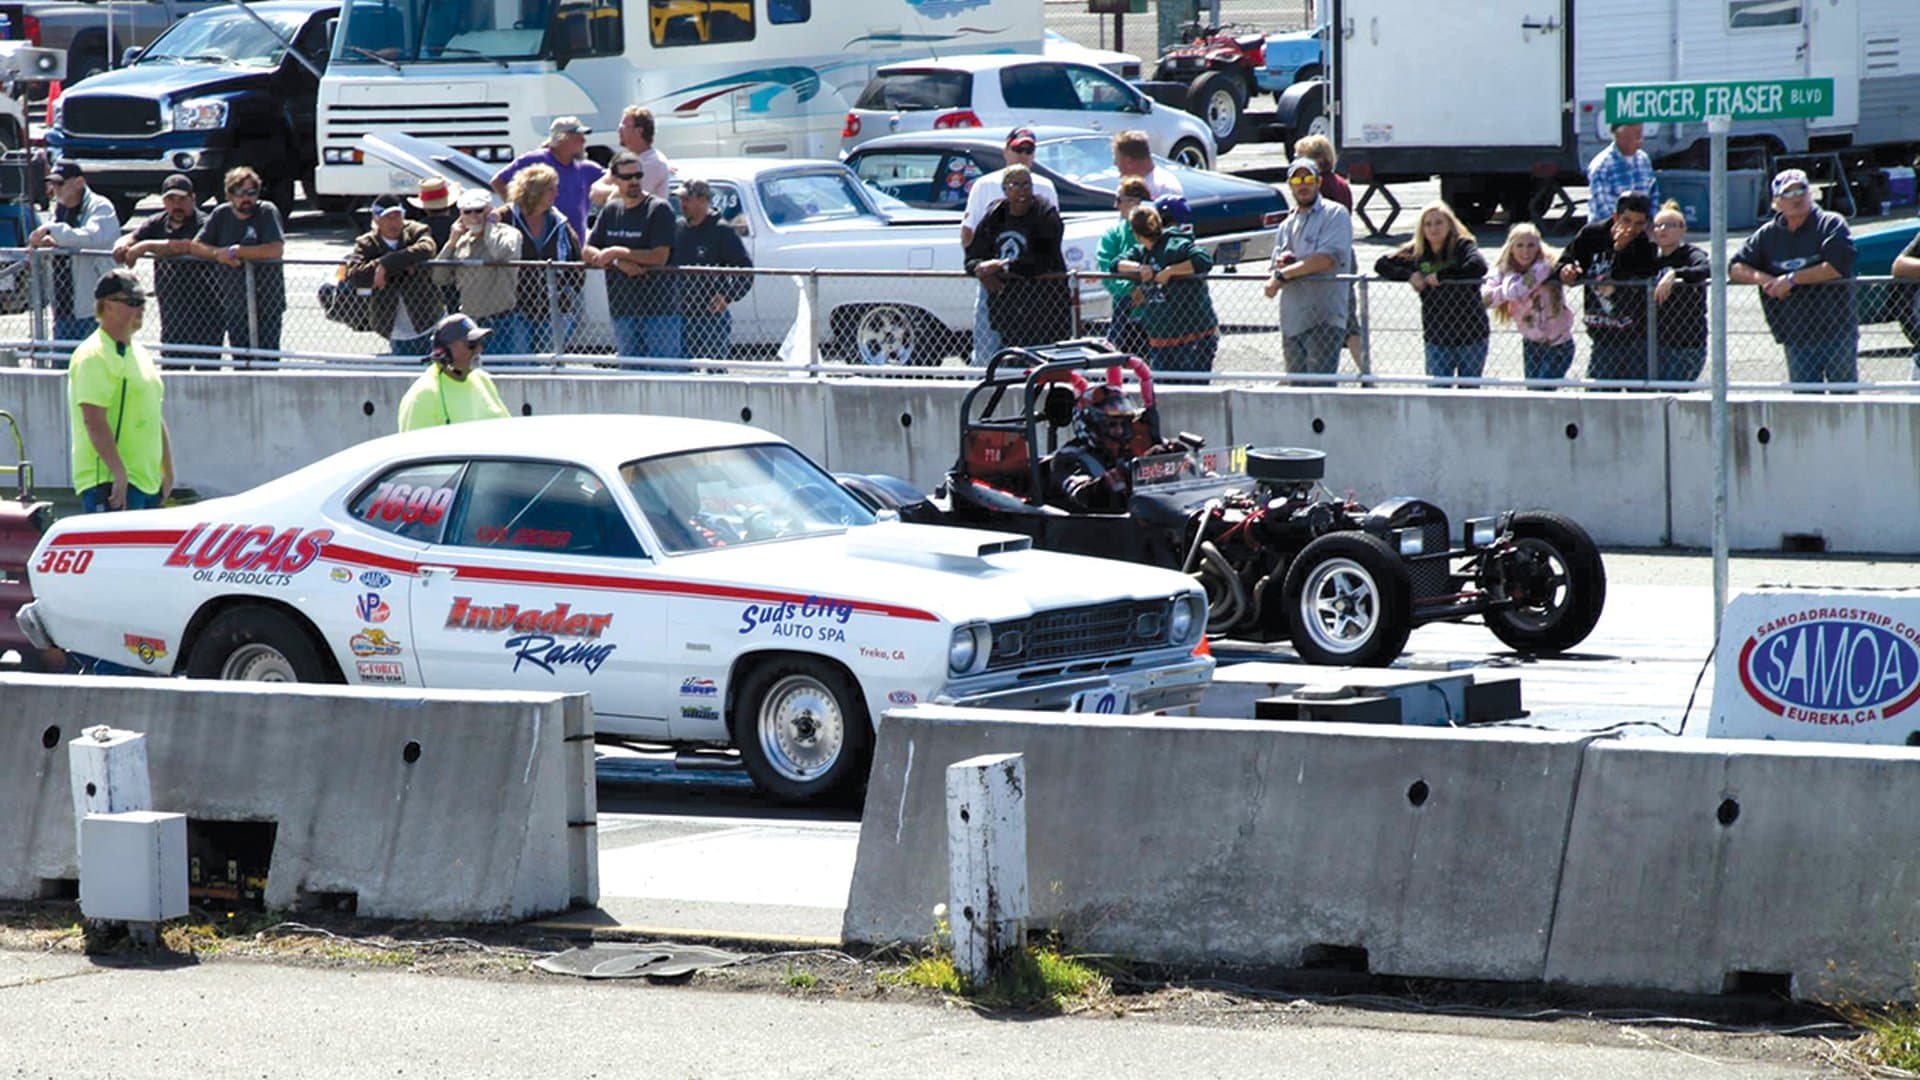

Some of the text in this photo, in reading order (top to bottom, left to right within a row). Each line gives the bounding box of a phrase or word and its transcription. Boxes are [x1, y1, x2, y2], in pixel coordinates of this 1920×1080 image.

[1617, 85, 1822, 118] MERCER, FRASER BLVD
[36, 550, 94, 574] 360
[164, 522, 336, 575] LUCAS
[193, 570, 292, 586] OIL PRODUCTS
[358, 592, 380, 622] VP
[444, 596, 614, 638] Invader
[739, 595, 854, 634] Suds City
[772, 623, 846, 643] AUTO SPA
[505, 634, 617, 675] Racing
[892, 650, 906, 661] CA
[1767, 625, 1904, 706] SAMOA
[1788, 707, 1876, 726] EUREKA,CA
